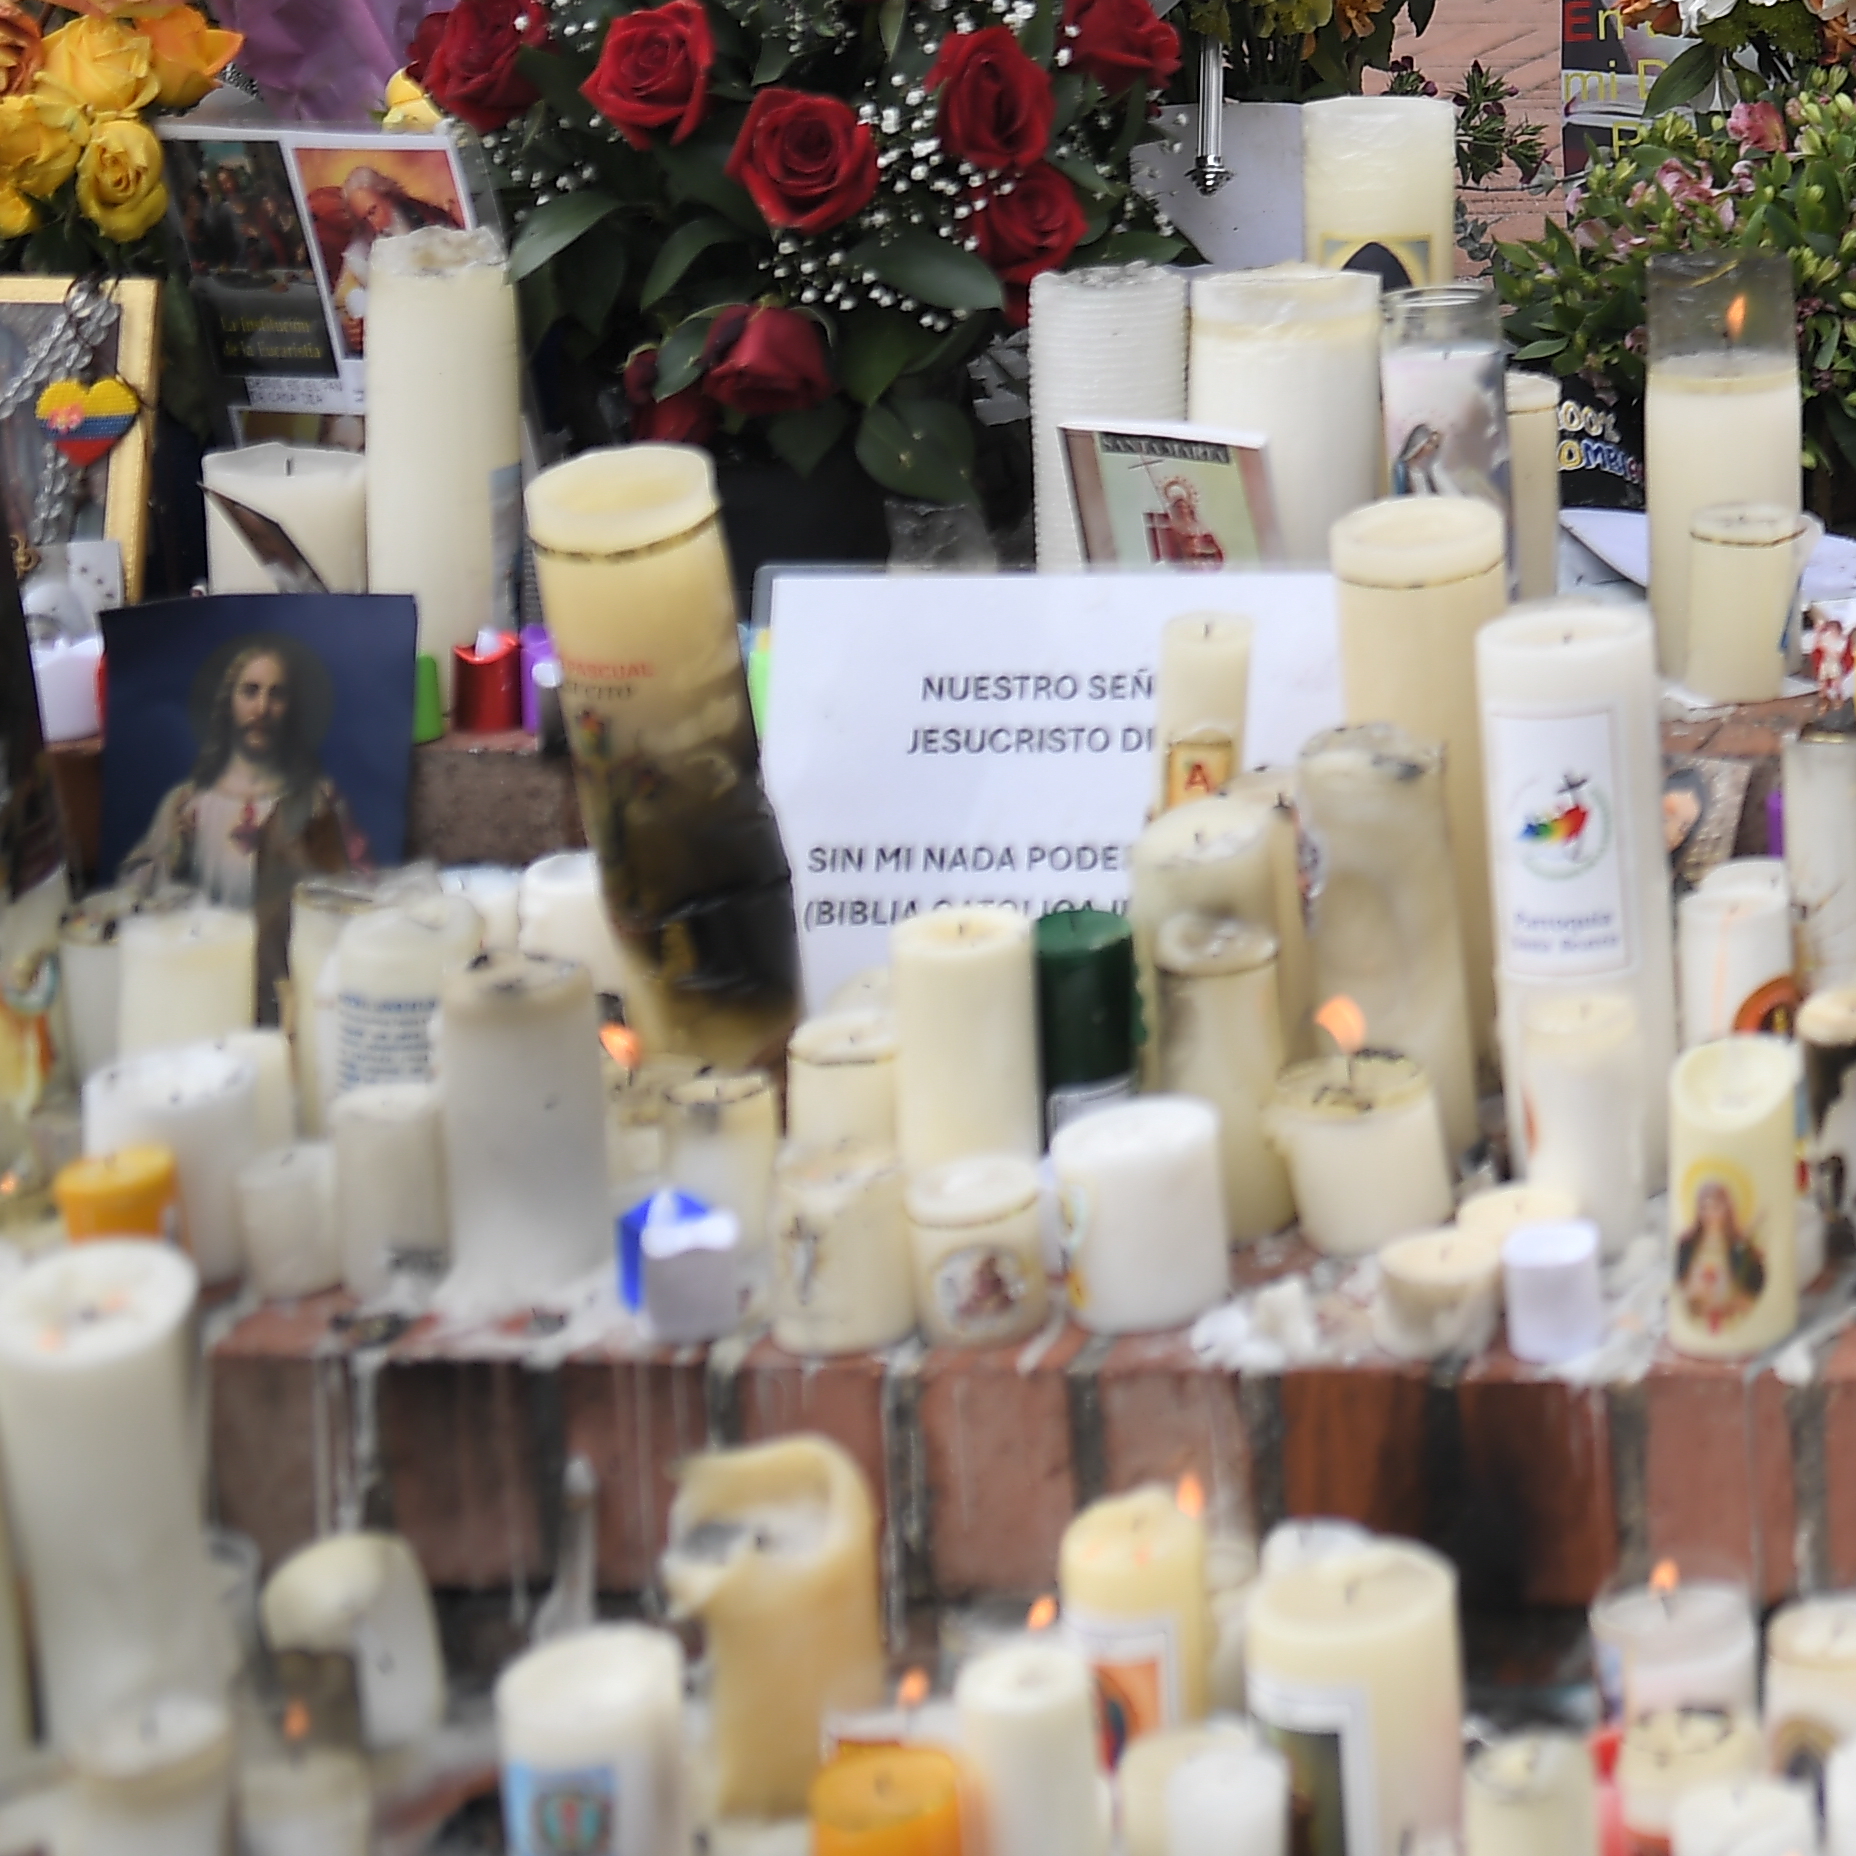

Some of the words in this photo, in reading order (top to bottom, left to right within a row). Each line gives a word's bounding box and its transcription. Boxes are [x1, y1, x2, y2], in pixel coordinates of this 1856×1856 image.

[1564, 58, 1618, 101] mi
[920, 674, 1078, 703] NUESTRO
[1087, 668, 1154, 702] SEÑ
[907, 726, 1111, 755] JESUCRISTO
[807, 846, 863, 873] SIN
[874, 845, 911, 872] MI
[921, 845, 1016, 872] NADA
[1026, 845, 1121, 872] PODE
